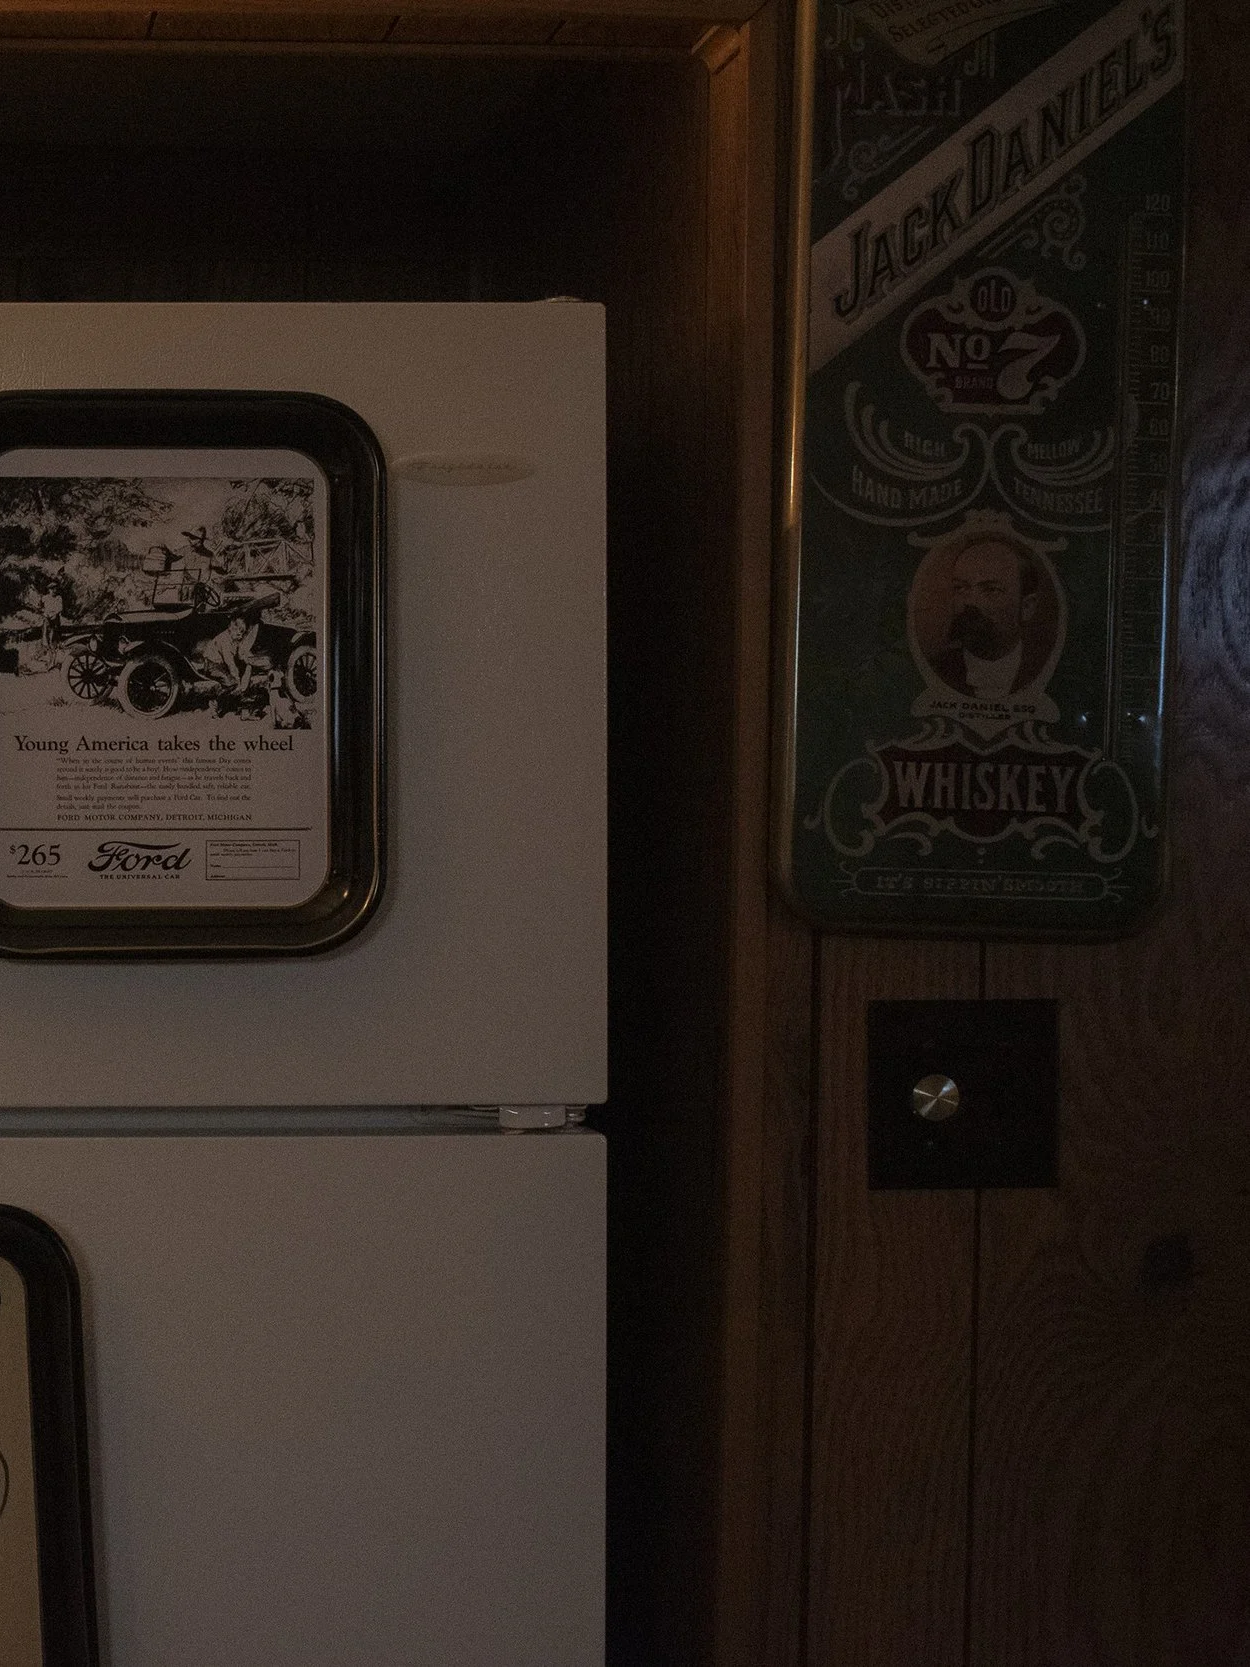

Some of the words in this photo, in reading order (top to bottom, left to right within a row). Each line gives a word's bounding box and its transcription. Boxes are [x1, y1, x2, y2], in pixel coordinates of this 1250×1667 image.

[888, 2, 969, 42] SELECTED
[832, 170, 961, 320] JACK
[968, 5, 1173, 219] DANIEL'S
[1145, 194, 1170, 211] 120
[978, 279, 1012, 312] OLD
[997, 331, 1061, 400] 7
[903, 430, 946, 457] RICH
[1027, 437, 1081, 460] MELLOW
[851, 465, 902, 509] HAND
[908, 479, 963, 509] MADE
[1013, 477, 1104, 514] TENNESSEE
[929, 701, 957, 709] JACK
[961, 702, 1009, 712] DANIEL
[14, 735, 69, 755] Young
[76, 735, 149, 751] America
[158, 735, 200, 751] takes
[209, 735, 236, 751] the
[244, 735, 293, 751] wheel
[73, 795, 94, 803] weekly
[96, 795, 125, 803] payments
[174, 795, 188, 803] Ford
[893, 761, 1075, 813] WHISKEY
[9, 844, 61, 866] $265
[88, 841, 192, 871] Ford
[876, 873, 914, 890] IT'S
